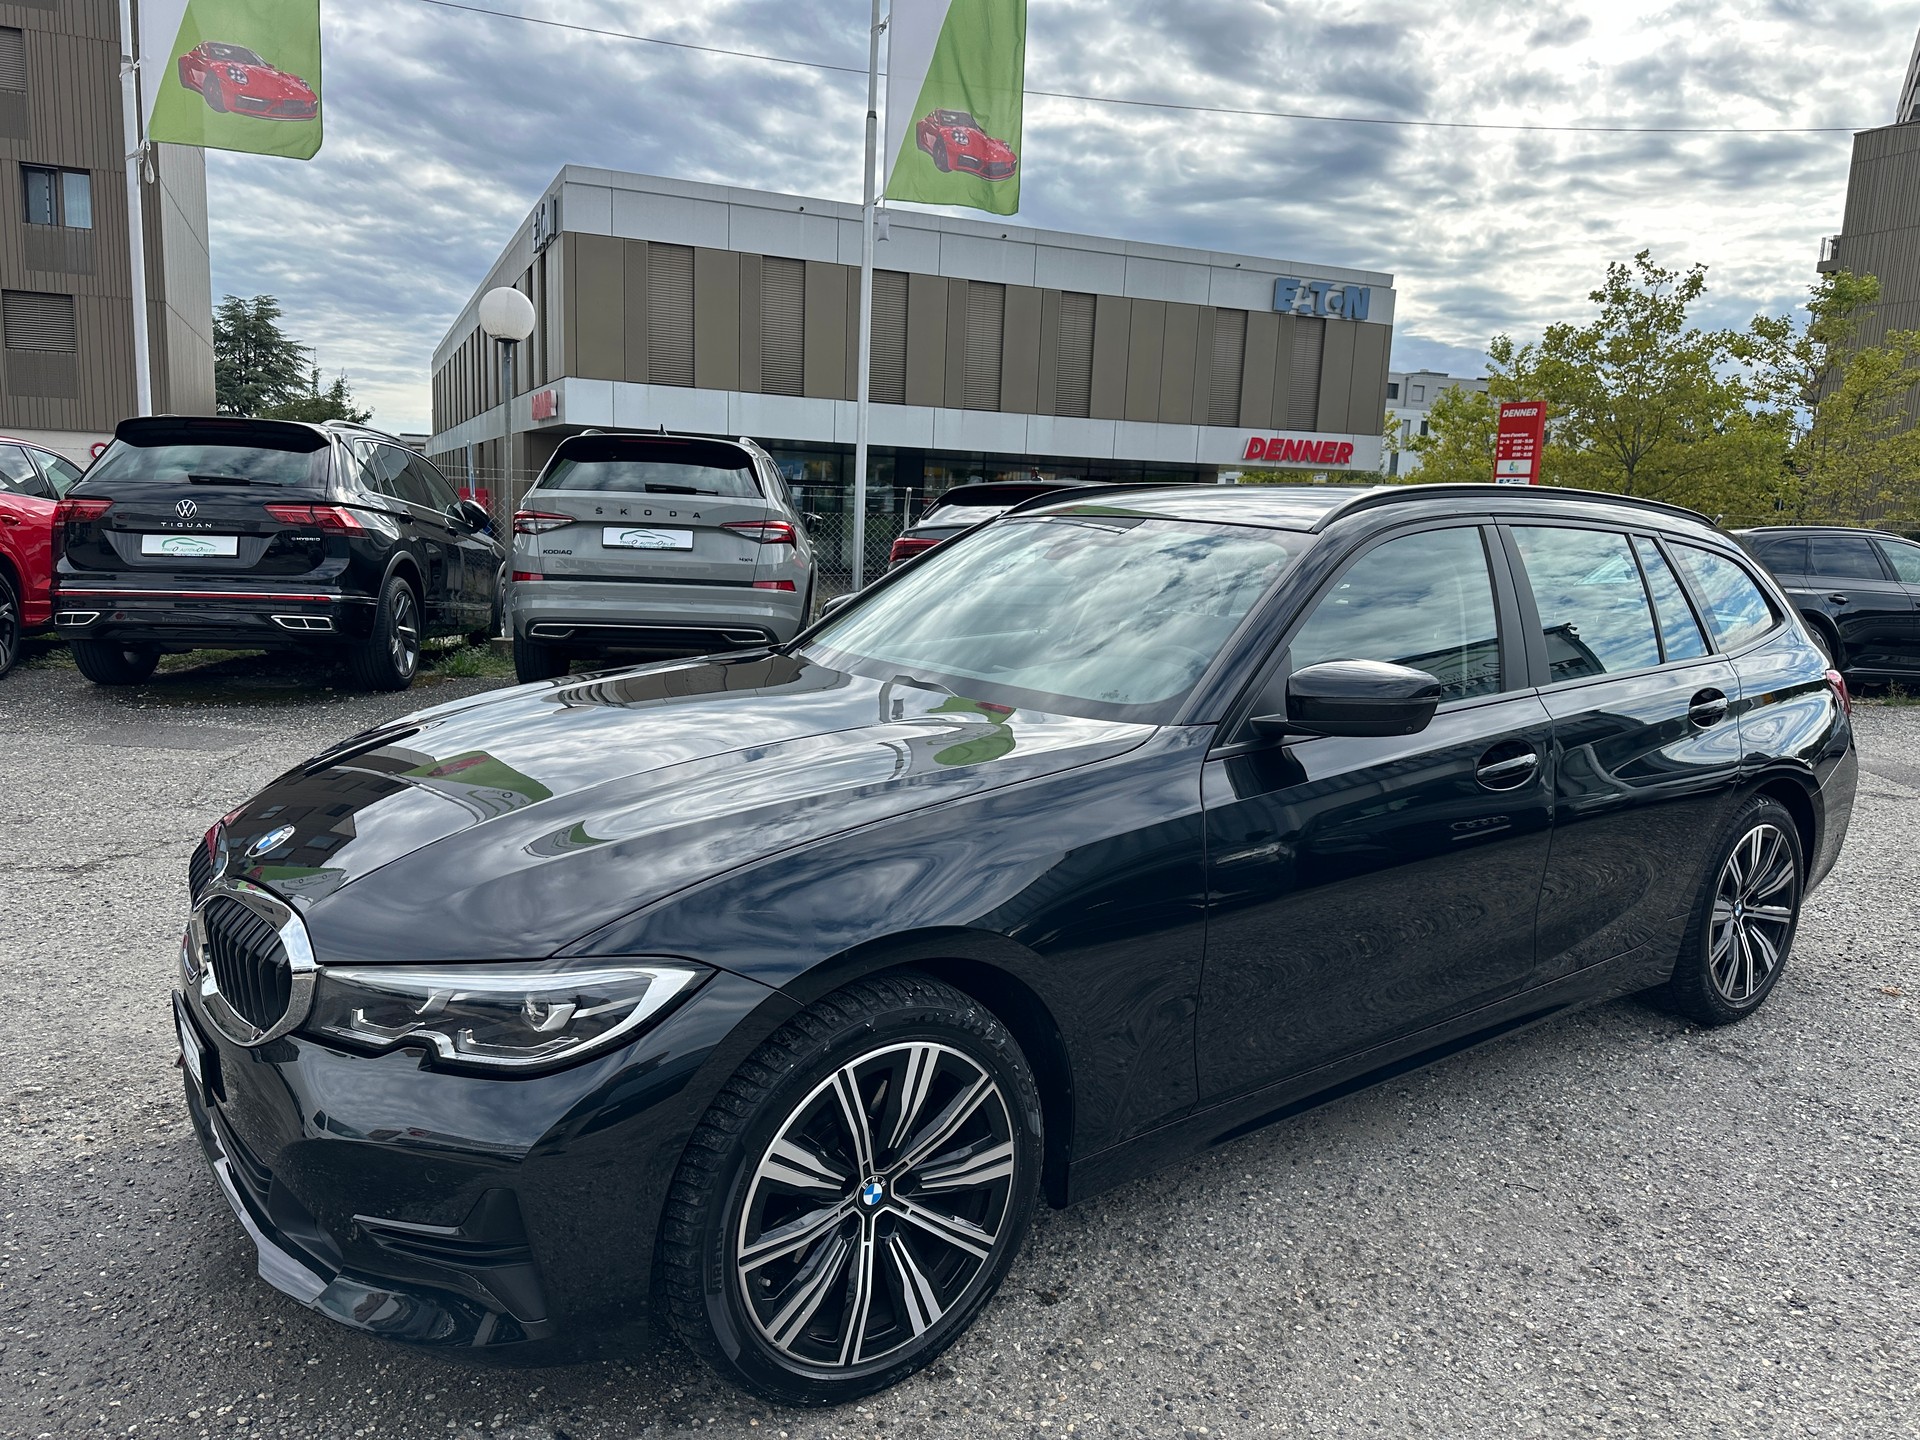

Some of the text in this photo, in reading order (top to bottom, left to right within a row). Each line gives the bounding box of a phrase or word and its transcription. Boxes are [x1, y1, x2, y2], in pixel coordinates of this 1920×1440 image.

[1273, 277, 1371, 320] EATON
[1502, 408, 1537, 417] DENNER
[1243, 437, 1354, 464] DENNER
[861, 1176, 887, 1190] BMW
